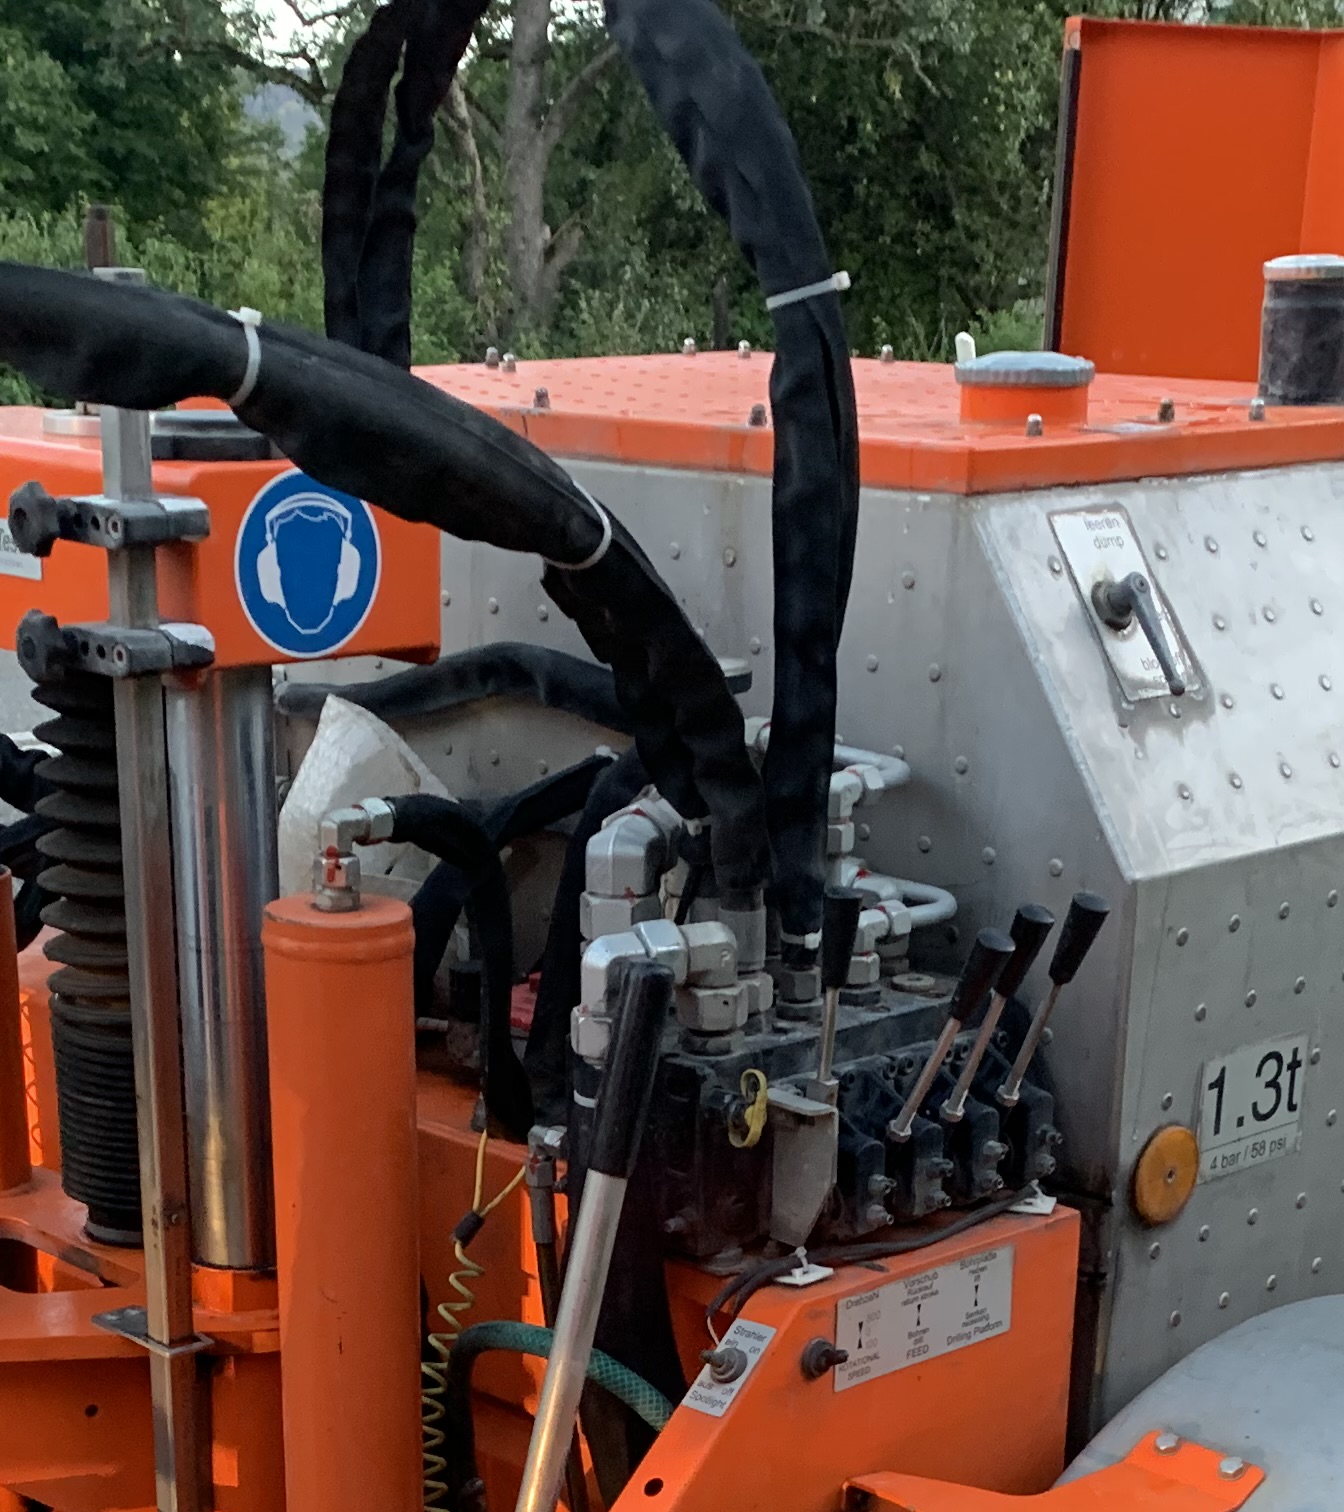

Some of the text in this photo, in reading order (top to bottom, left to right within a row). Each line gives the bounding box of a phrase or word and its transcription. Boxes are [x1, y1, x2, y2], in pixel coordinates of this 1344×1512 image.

[1093, 535, 1125, 550] dump
[1208, 1047, 1302, 1136] 1.3t
[1210, 1156, 1218, 1170] 4
[1221, 1151, 1242, 1169] bar
[1251, 1140, 1266, 1159] 58
[1269, 1137, 1287, 1156] psi
[947, 1319, 1003, 1346] Drilling Platform
[749, 1346, 761, 1355] on
[906, 1344, 929, 1360] FEED
